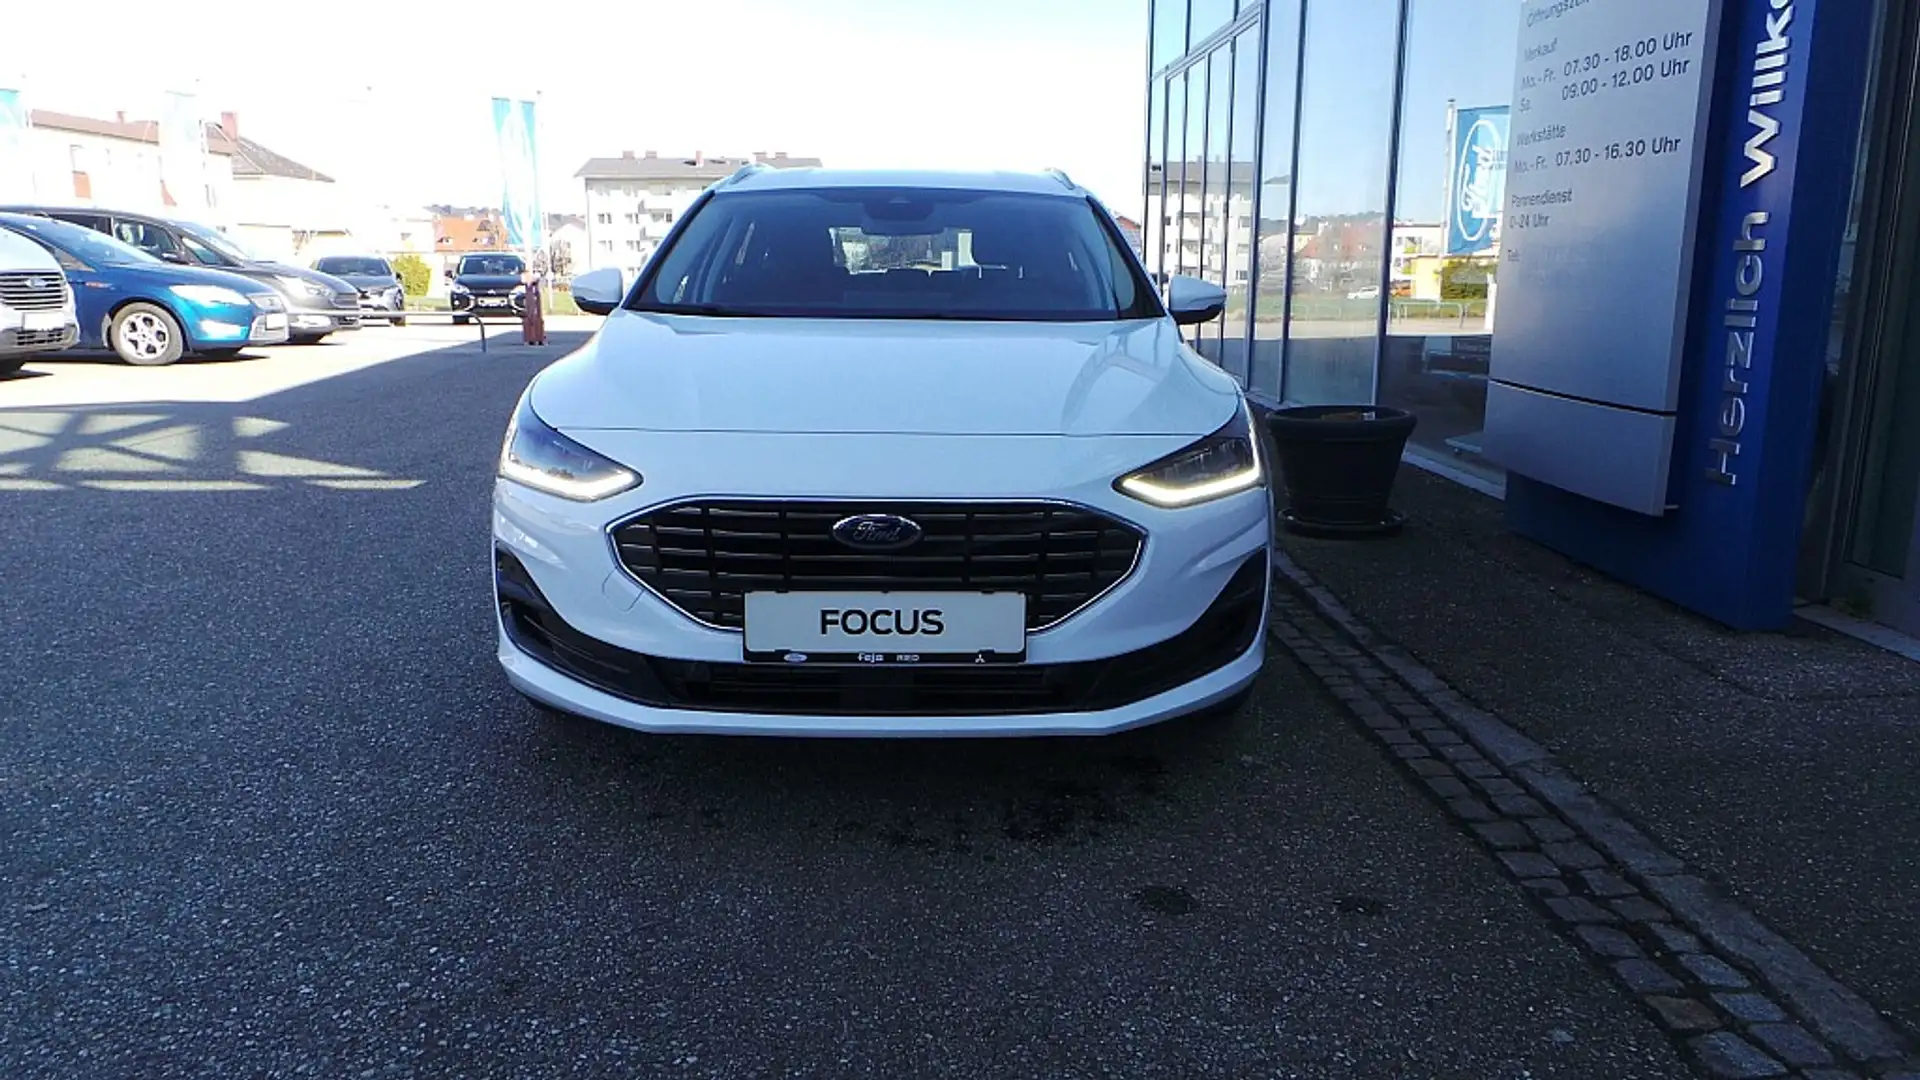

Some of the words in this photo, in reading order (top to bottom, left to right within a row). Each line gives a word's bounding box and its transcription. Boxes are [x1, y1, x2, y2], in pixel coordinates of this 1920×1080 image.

[1563, 53, 1600, 76] 07.30
[1614, 37, 1657, 63] 18.00
[1663, 31, 1693, 51] Uhr
[1562, 78, 1598, 101] 09.00
[1612, 63, 1654, 88] 12.00
[1660, 58, 1690, 78] Uhr
[1556, 147, 1591, 167] 07.30
[1604, 139, 1646, 160] 16.30
[1652, 136, 1681, 154] Uhr
[1533, 213, 1550, 228] Uhr
[1704, 211, 1770, 486] Herzlich
[853, 521, 902, 541] Ford
[820, 608, 945, 635] FOCUS
